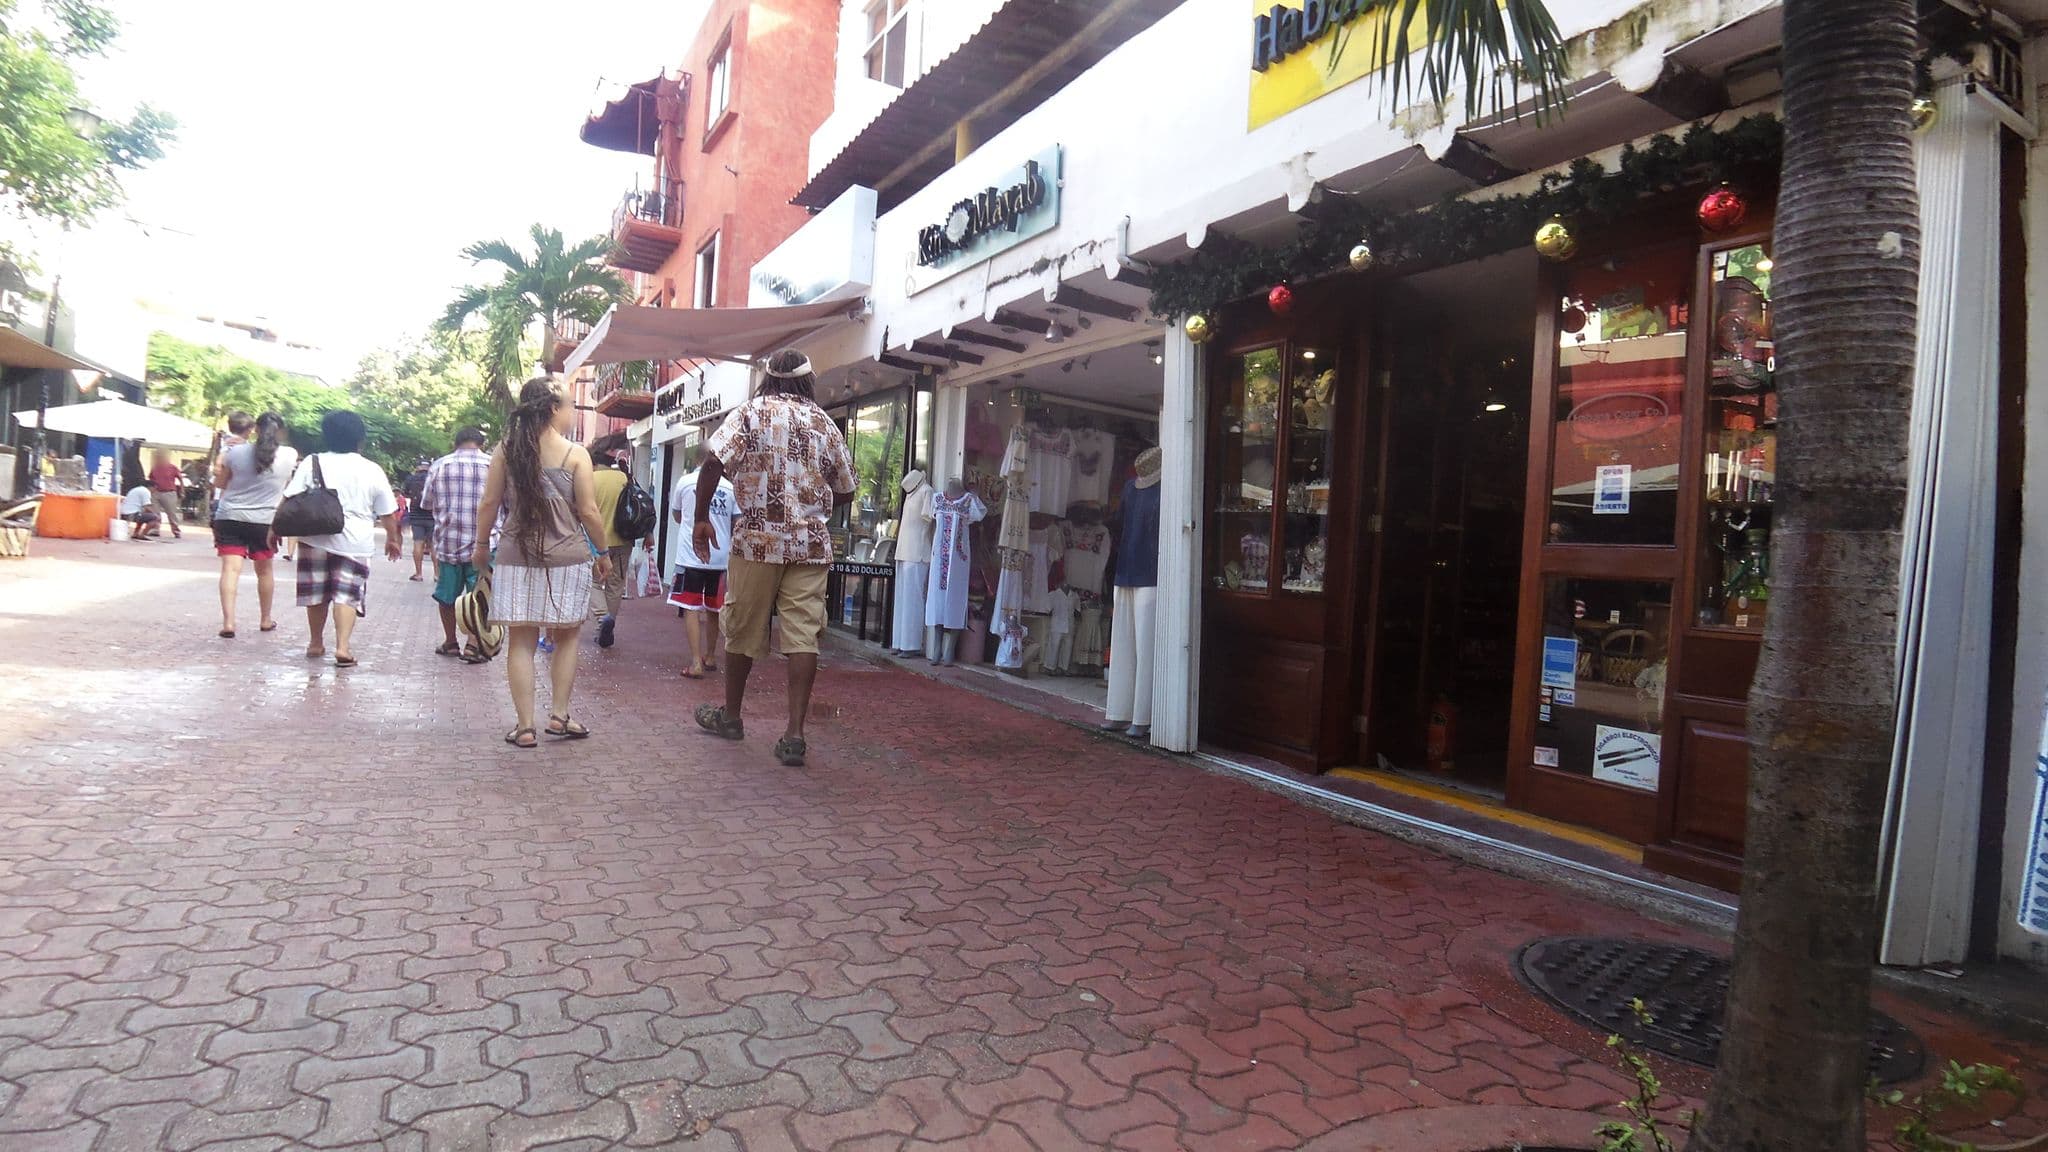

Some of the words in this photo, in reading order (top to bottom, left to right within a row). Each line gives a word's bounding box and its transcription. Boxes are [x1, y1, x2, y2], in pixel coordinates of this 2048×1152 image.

[973, 159, 1046, 233] Mayab
[852, 565, 860, 573] 20
[861, 566, 893, 576] DOLLARS
[1557, 692, 1573, 701] VISA
